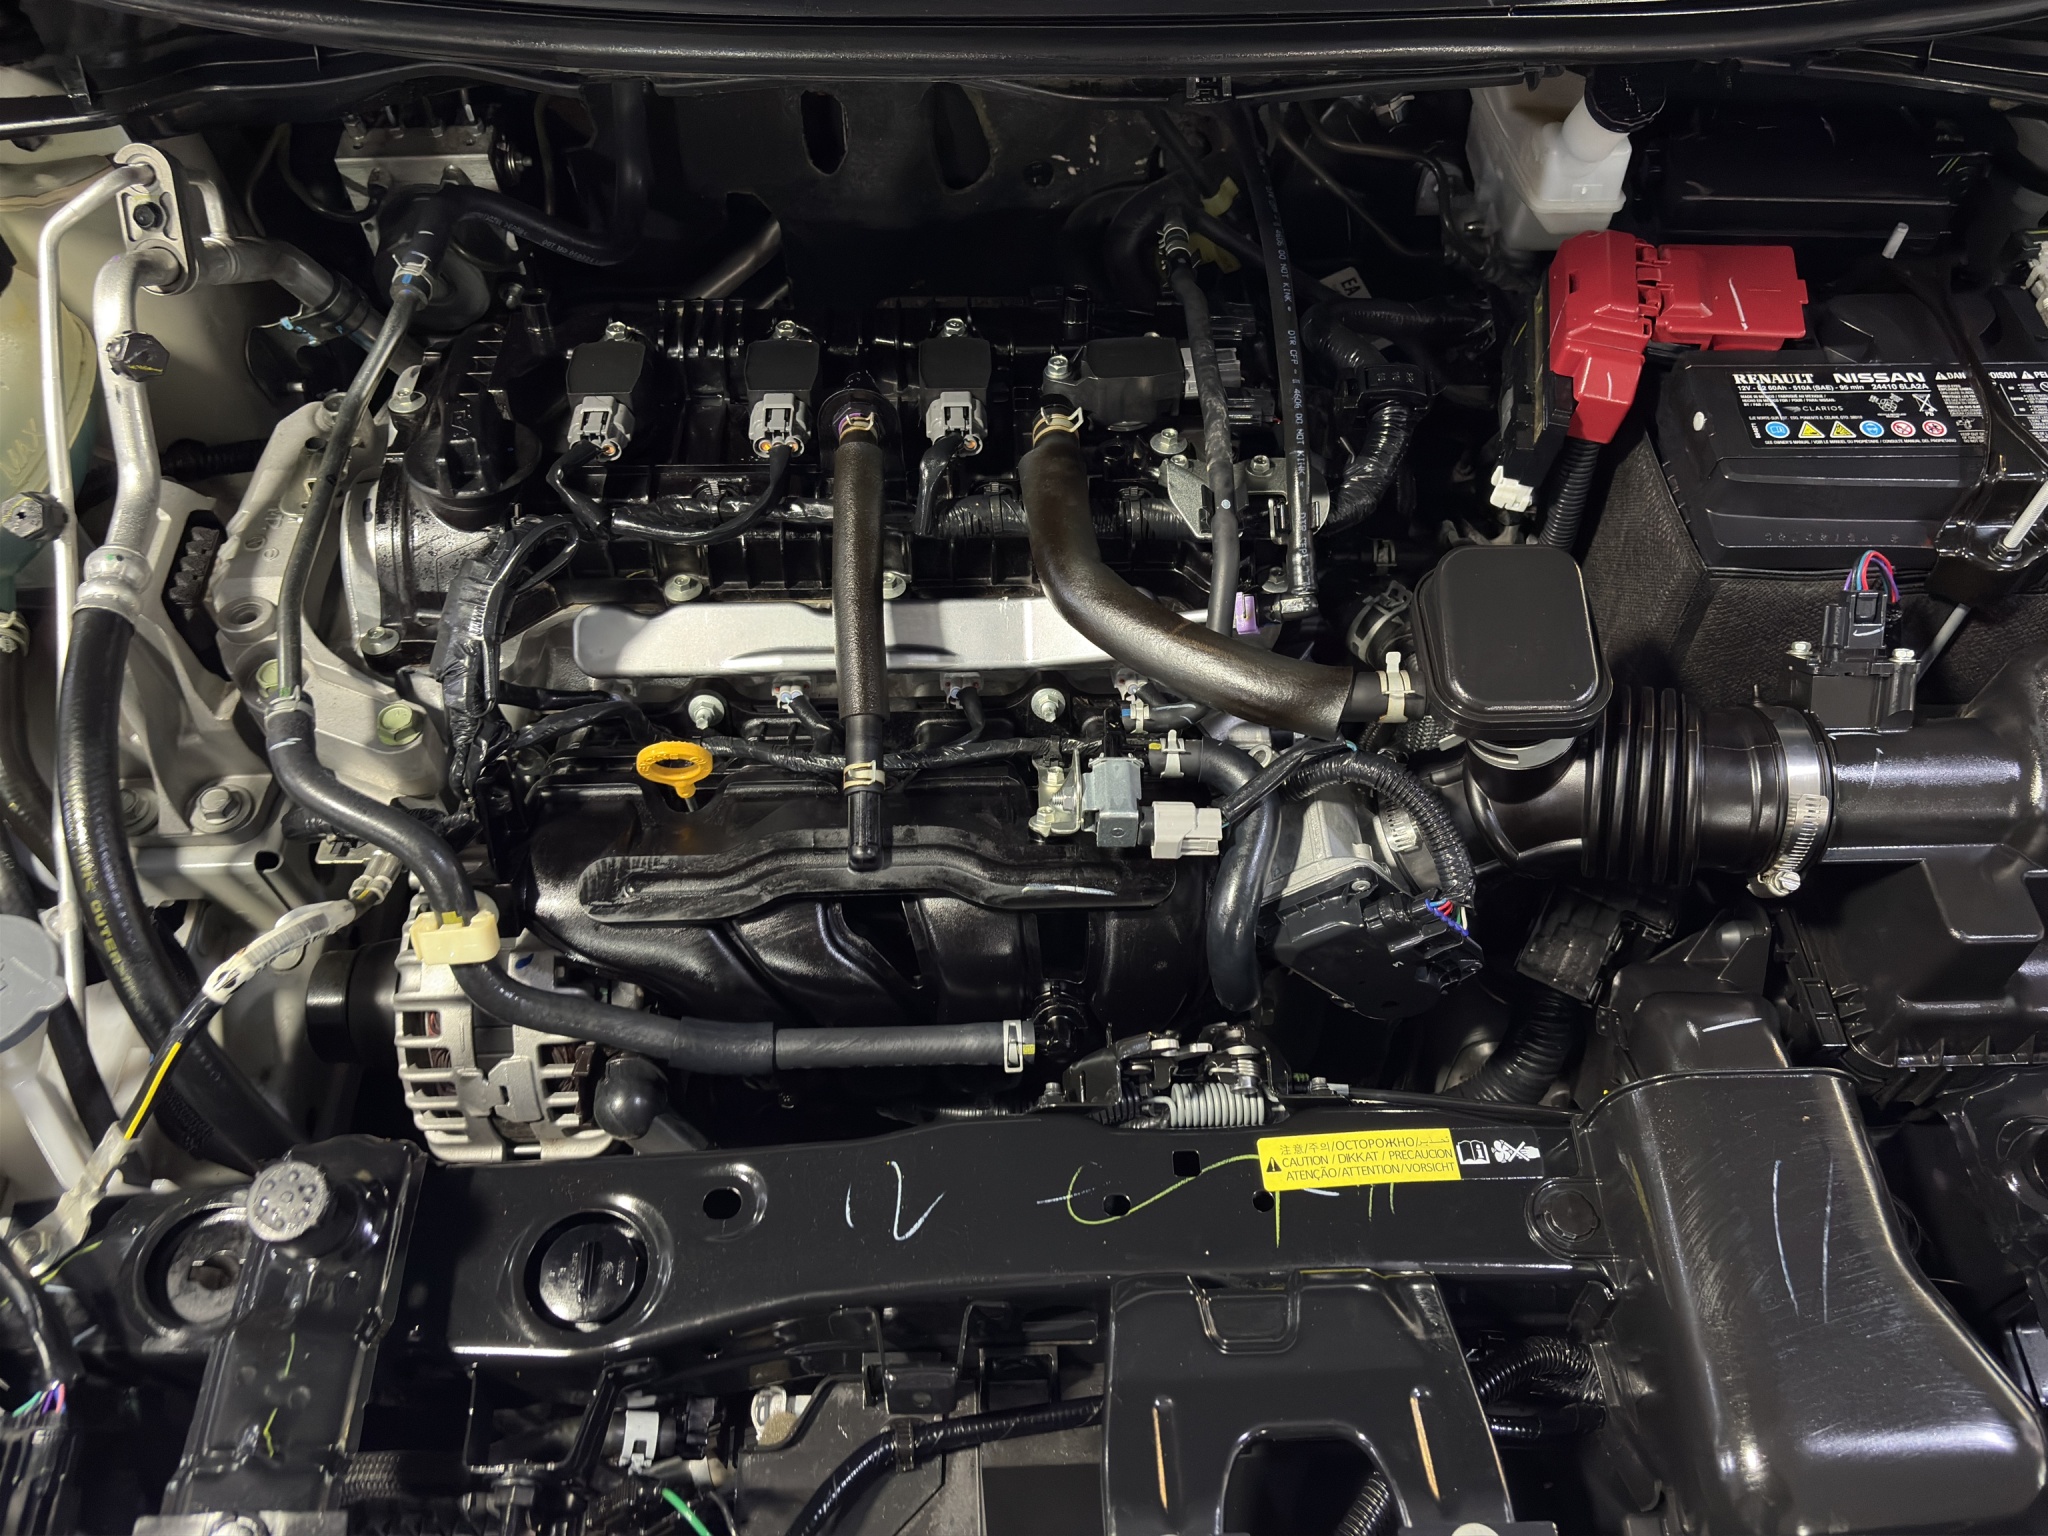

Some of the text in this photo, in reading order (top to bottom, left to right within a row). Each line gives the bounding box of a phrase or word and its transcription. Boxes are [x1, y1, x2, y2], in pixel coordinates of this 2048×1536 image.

[1732, 373, 1814, 384] RENAULT
[1833, 372, 1926, 384] NISSAN
[1812, 384, 1834, 392] (SAE)
[1282, 1155, 1329, 1168] CAUTION
